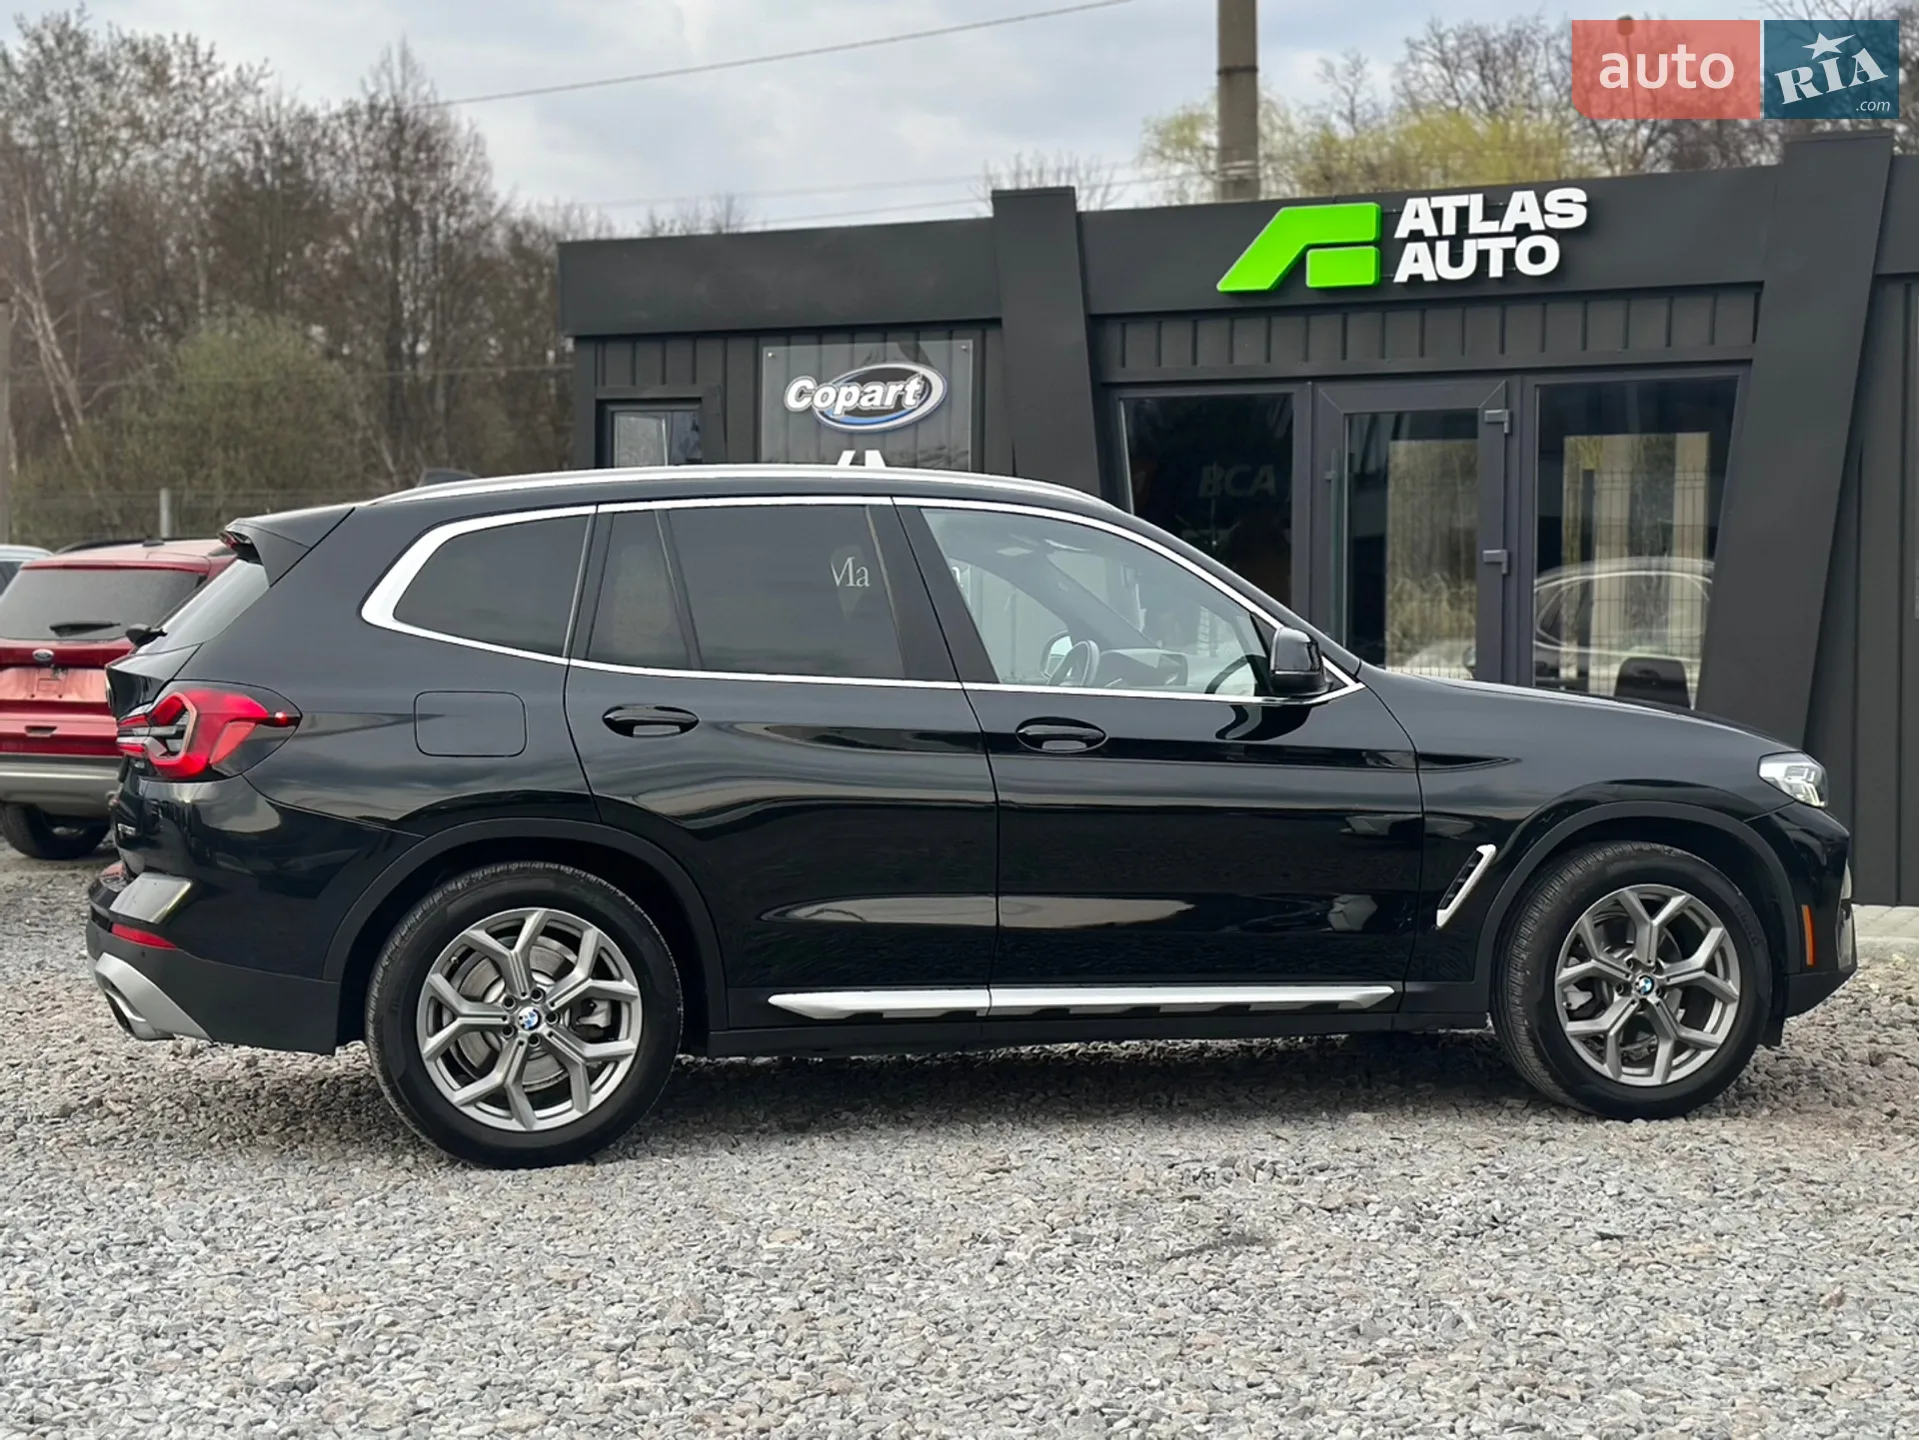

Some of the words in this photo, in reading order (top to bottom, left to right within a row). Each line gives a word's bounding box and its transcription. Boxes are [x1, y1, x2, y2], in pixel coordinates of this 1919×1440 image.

[1393, 187, 1588, 239] ATLAS
[1393, 235, 1560, 283] AUTO
[785, 372, 925, 416] Copart
[1197, 464, 1277, 497] BCA
